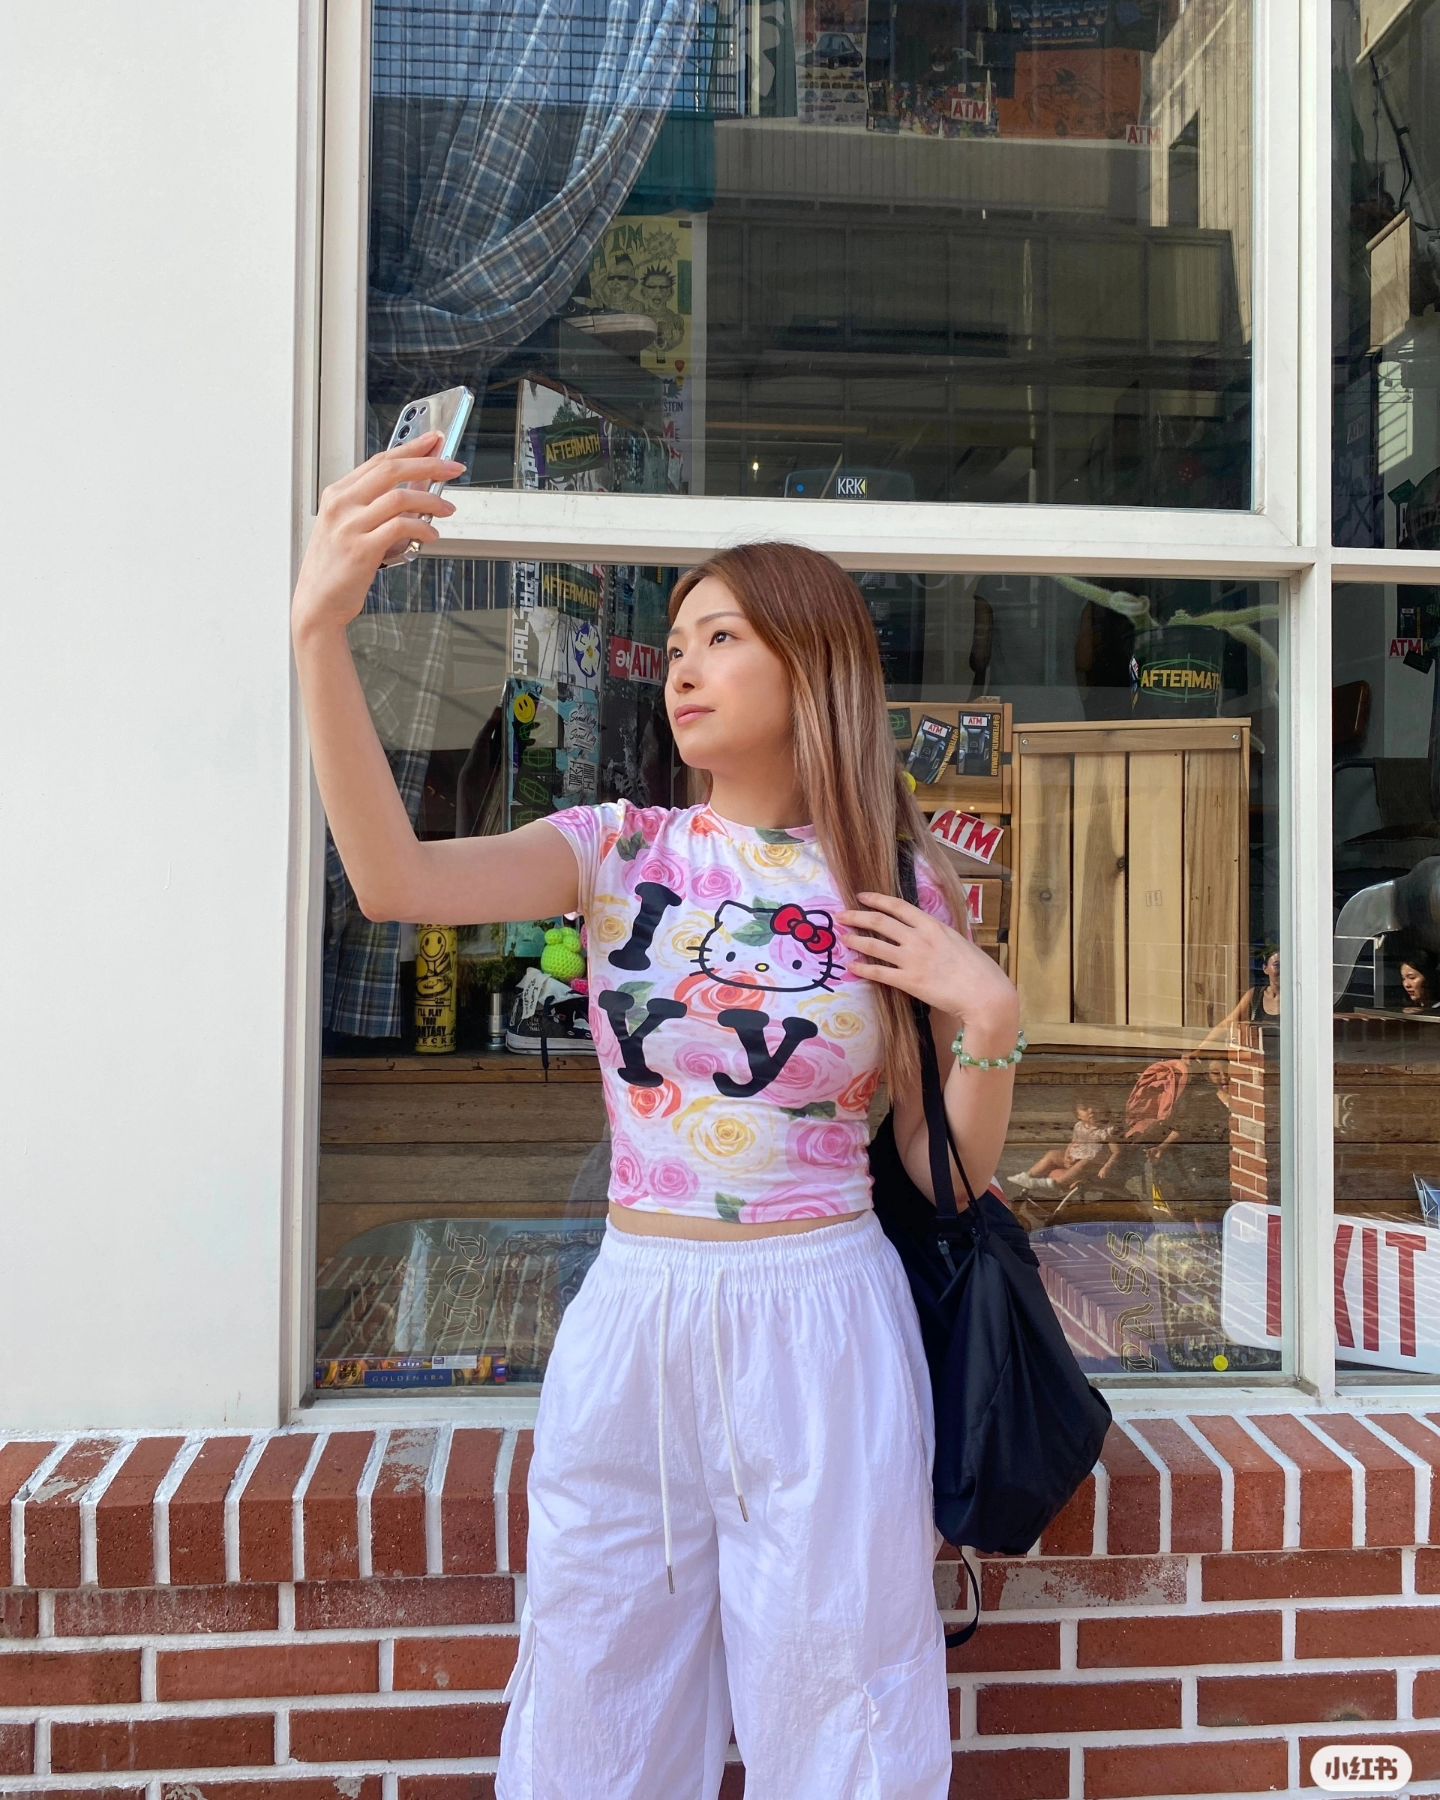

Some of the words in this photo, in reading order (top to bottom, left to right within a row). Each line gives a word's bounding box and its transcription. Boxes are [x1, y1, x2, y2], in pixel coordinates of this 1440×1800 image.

[953, 101, 987, 120] ATM
[1127, 126, 1161, 145] ATM
[546, 433, 600, 464] AFTERMATH
[838, 478, 863, 494] KRK
[543, 575, 599, 608] AFTERMATH
[1390, 639, 1422, 656] ATM
[631, 645, 662, 680] ATM
[968, 717, 982, 726] ATM
[930, 809, 1002, 859] ATM
[608, 882, 682, 970] I
[372, 1374, 420, 1382] GOLDEN
[424, 1374, 445, 1382] ERA
